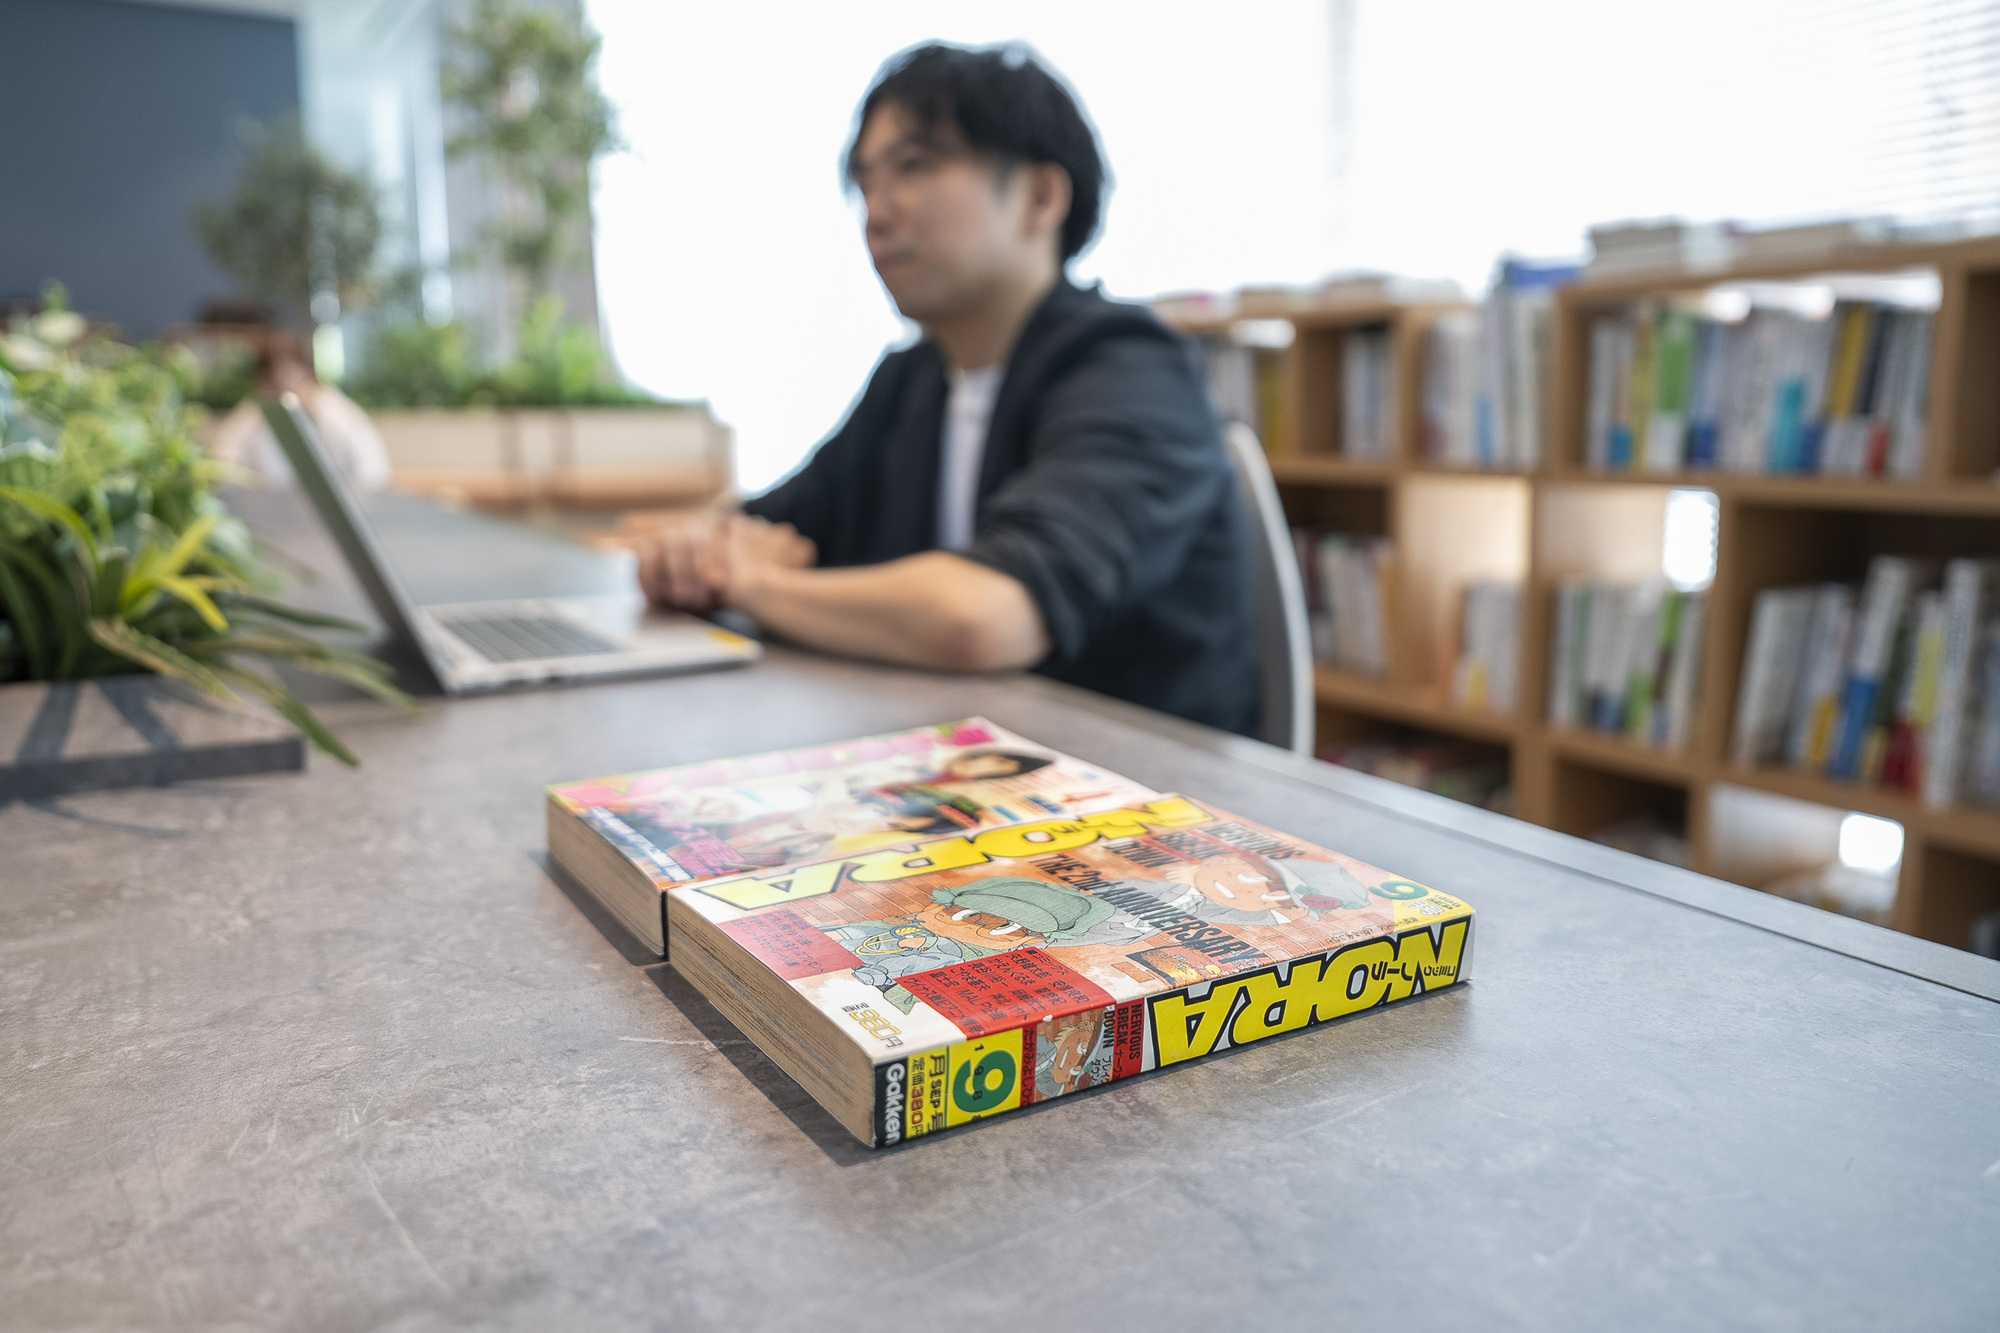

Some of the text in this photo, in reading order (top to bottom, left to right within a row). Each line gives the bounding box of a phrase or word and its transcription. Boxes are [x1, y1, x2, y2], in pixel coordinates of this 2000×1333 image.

[693, 796, 1216, 910] NORA
[1103, 837, 1181, 868] DOWN
[1153, 832, 1229, 861] BREAK
[1203, 821, 1305, 860] NERVOUS
[1028, 853, 1088, 875] THE
[1057, 869, 1123, 894] 2nd
[1368, 880, 1429, 900] 9
[1427, 898, 1453, 910] SEP
[1095, 885, 1270, 965] ANNIVERSARY
[986, 957, 1038, 985] かえんぐるま
[1004, 953, 1053, 978] 矢野健太郎
[1031, 953, 1071, 975] コミックス
[1150, 917, 1470, 1067] NORA
[1103, 1011, 1116, 1049] DOWN
[1116, 1006, 1129, 1047] BREAK
[1129, 1004, 1143, 1060] NERVOUS
[953, 1050, 1016, 1113] 9
[885, 1063, 906, 1146] Gakken
